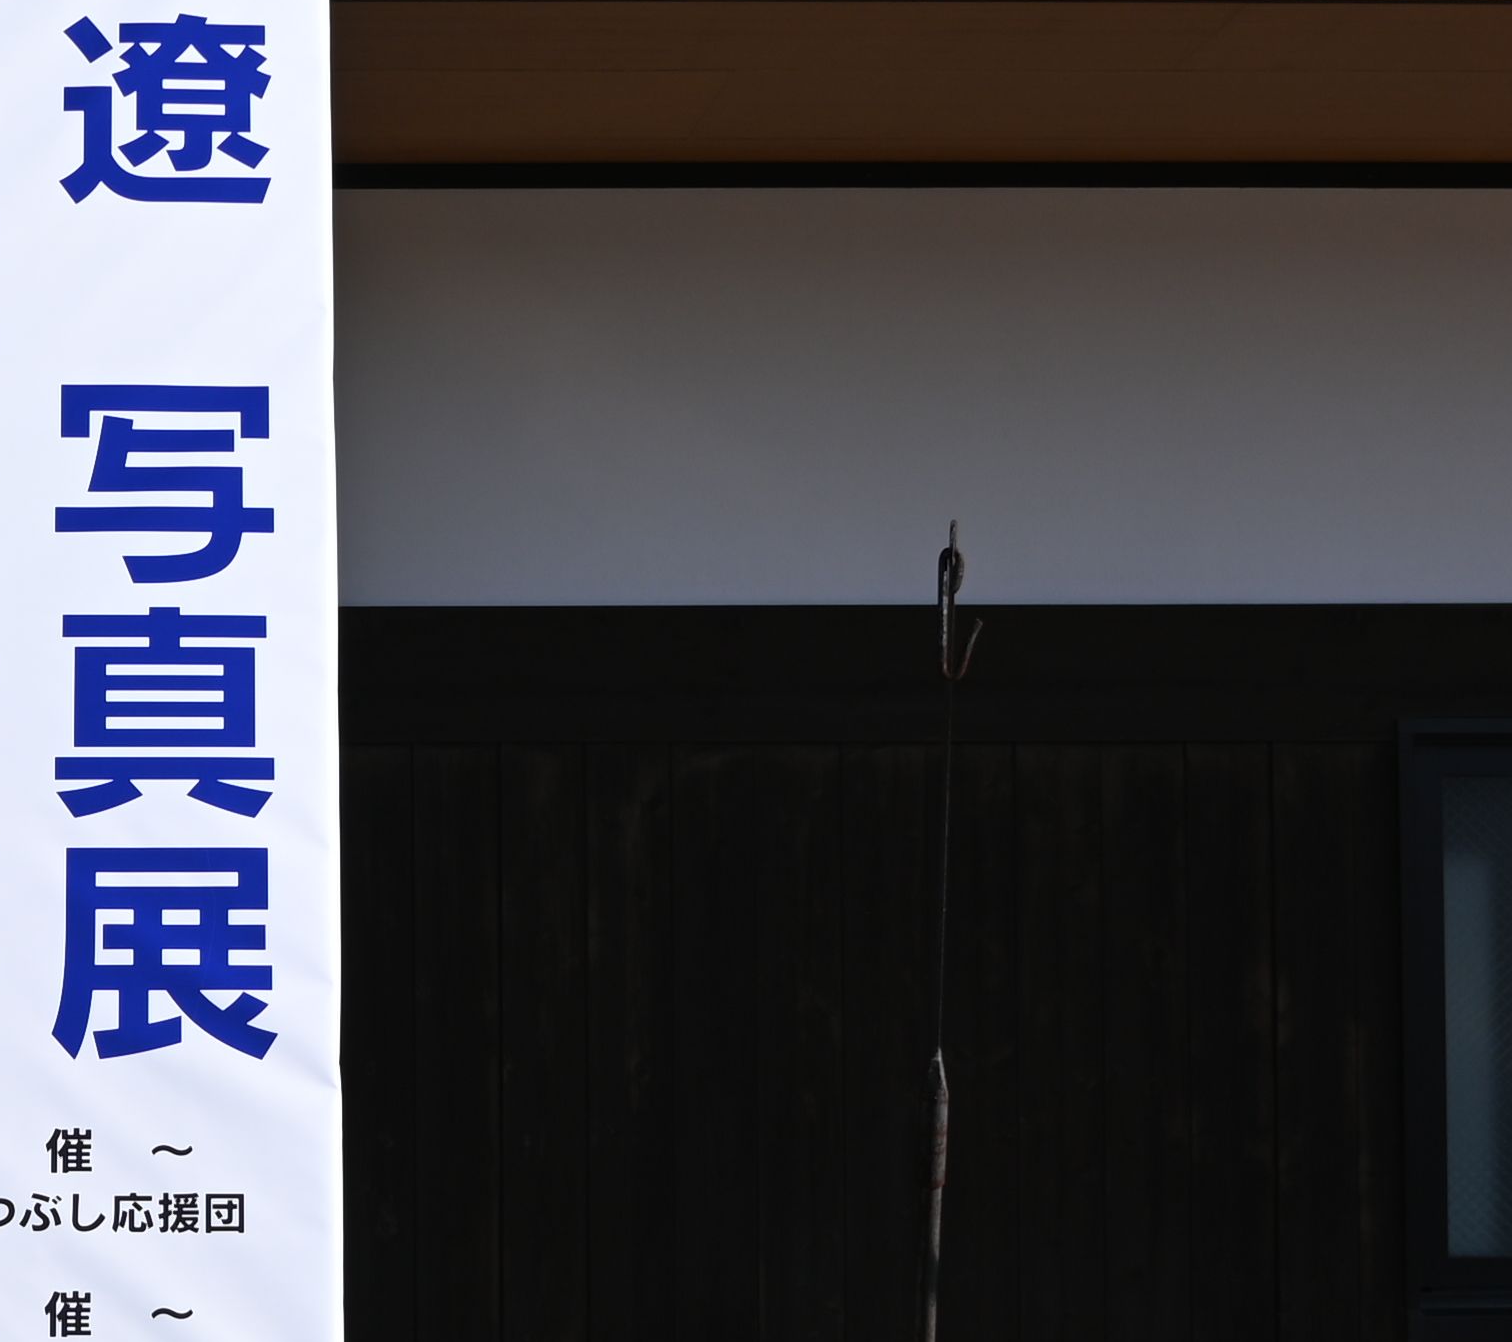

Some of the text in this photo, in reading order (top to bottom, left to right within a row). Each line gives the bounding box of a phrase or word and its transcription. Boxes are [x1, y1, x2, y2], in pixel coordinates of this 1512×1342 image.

[59, 12, 272, 204] 遼
[51, 383, 278, 1060] 写真展
